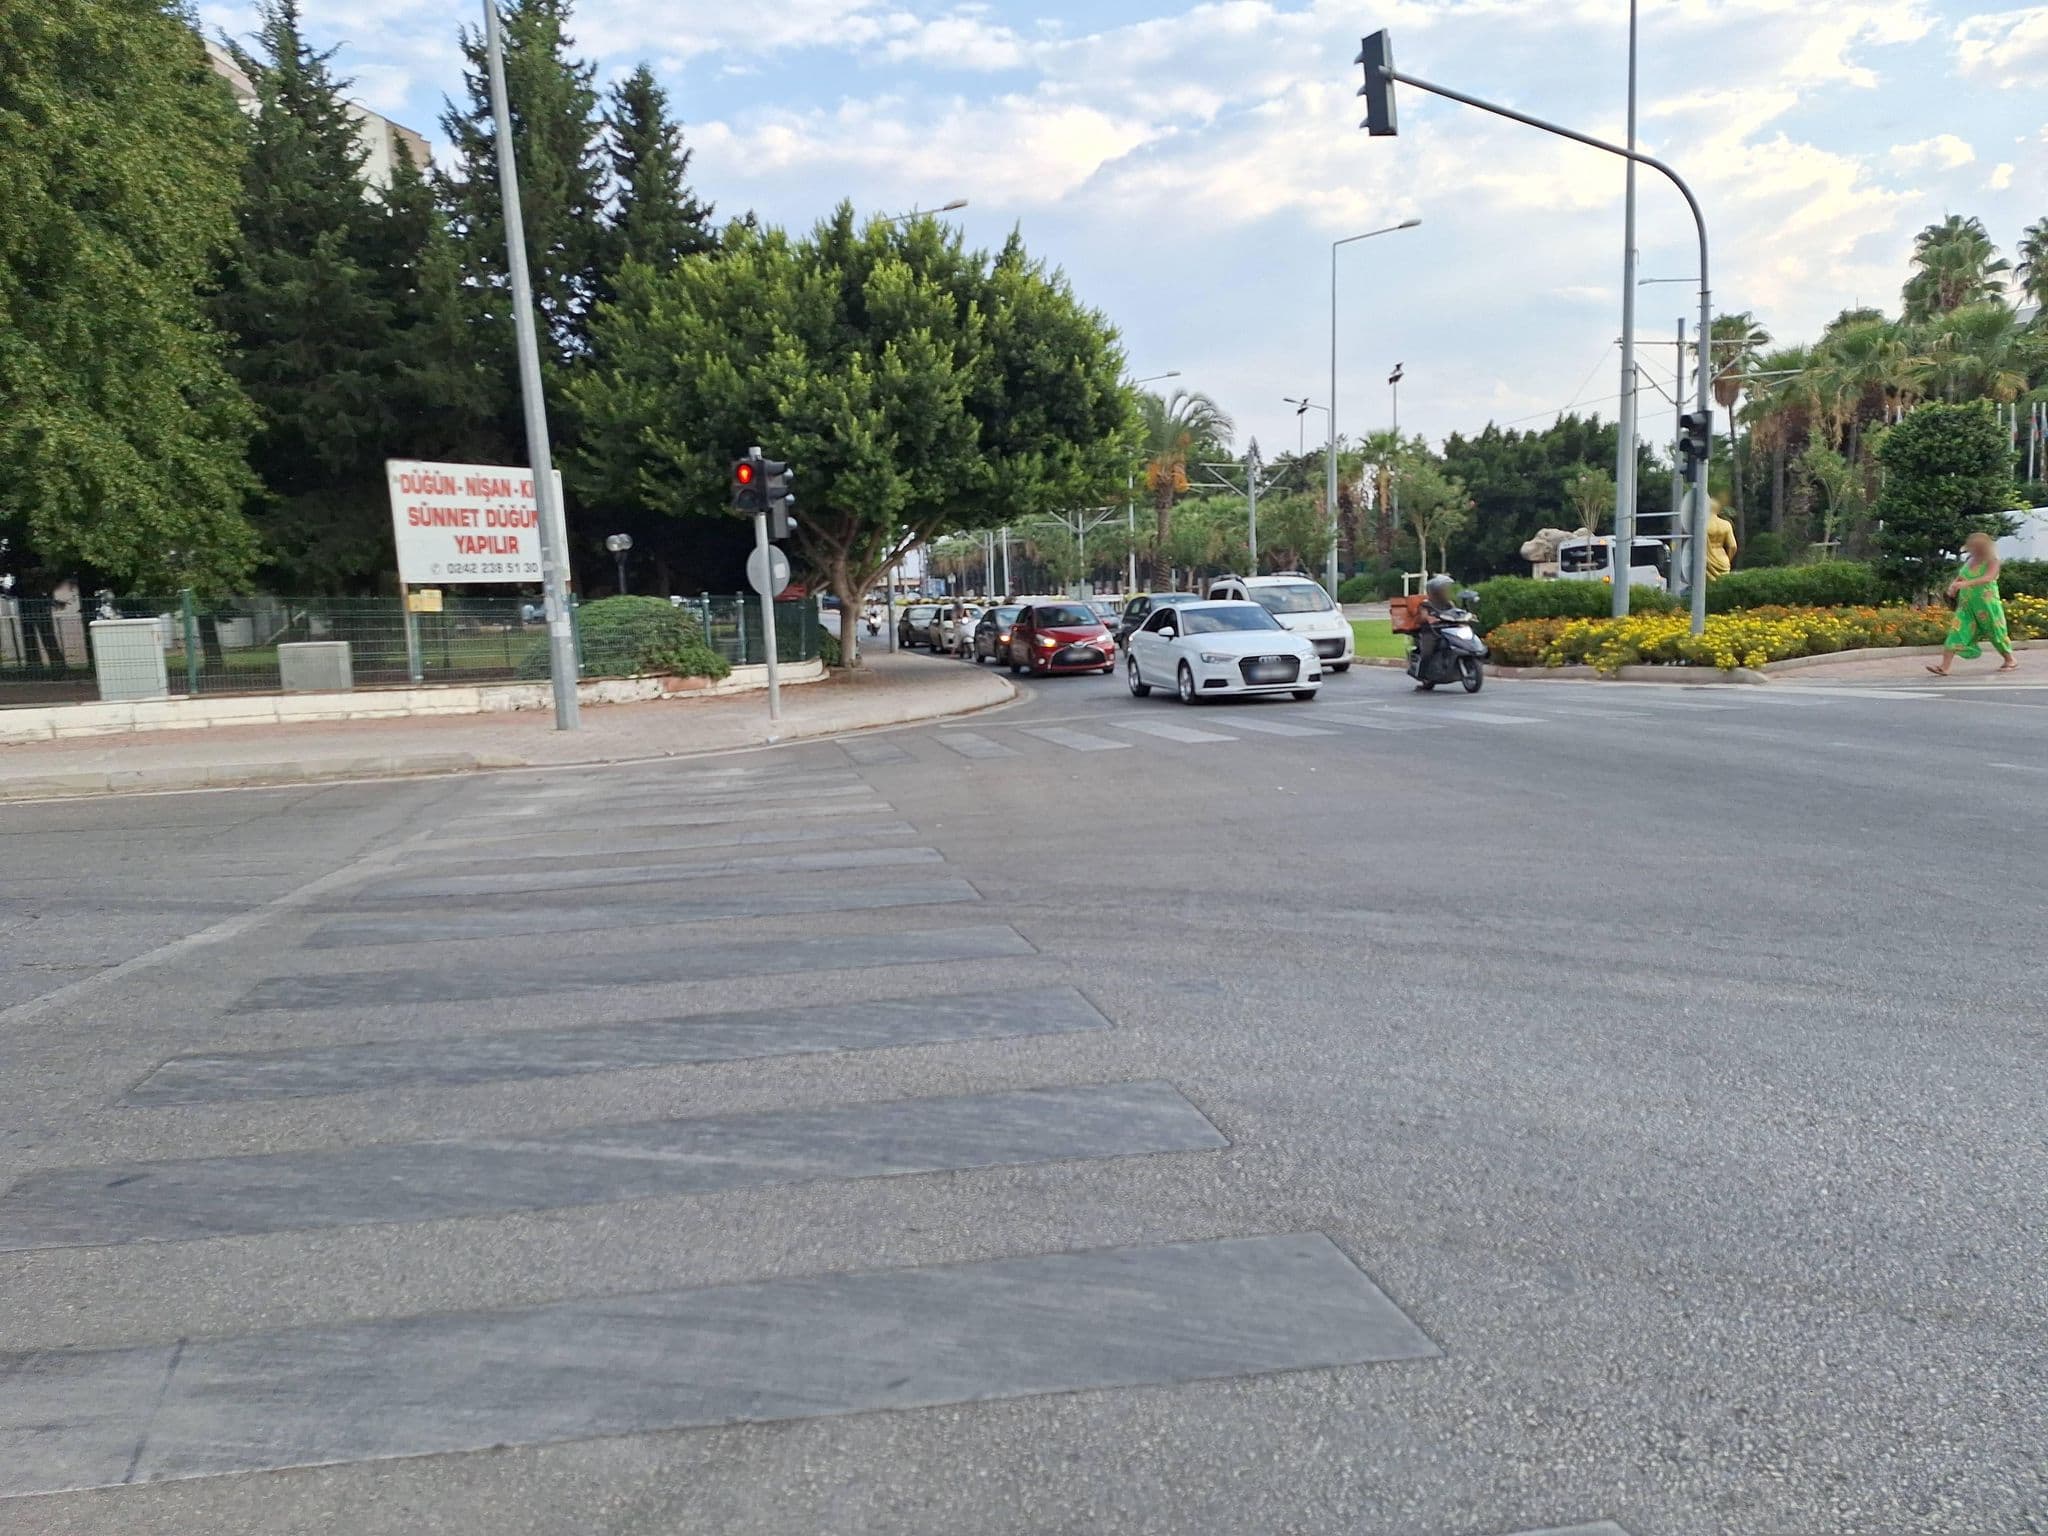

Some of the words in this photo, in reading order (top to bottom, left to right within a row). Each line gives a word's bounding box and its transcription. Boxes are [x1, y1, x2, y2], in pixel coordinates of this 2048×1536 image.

[400, 469, 456, 495] DÜĞÜN
[464, 472, 511, 502] NİŞAN
[408, 502, 479, 527] SÜNNET
[455, 535, 519, 554] YAPILIR
[447, 562, 477, 574] 0242
